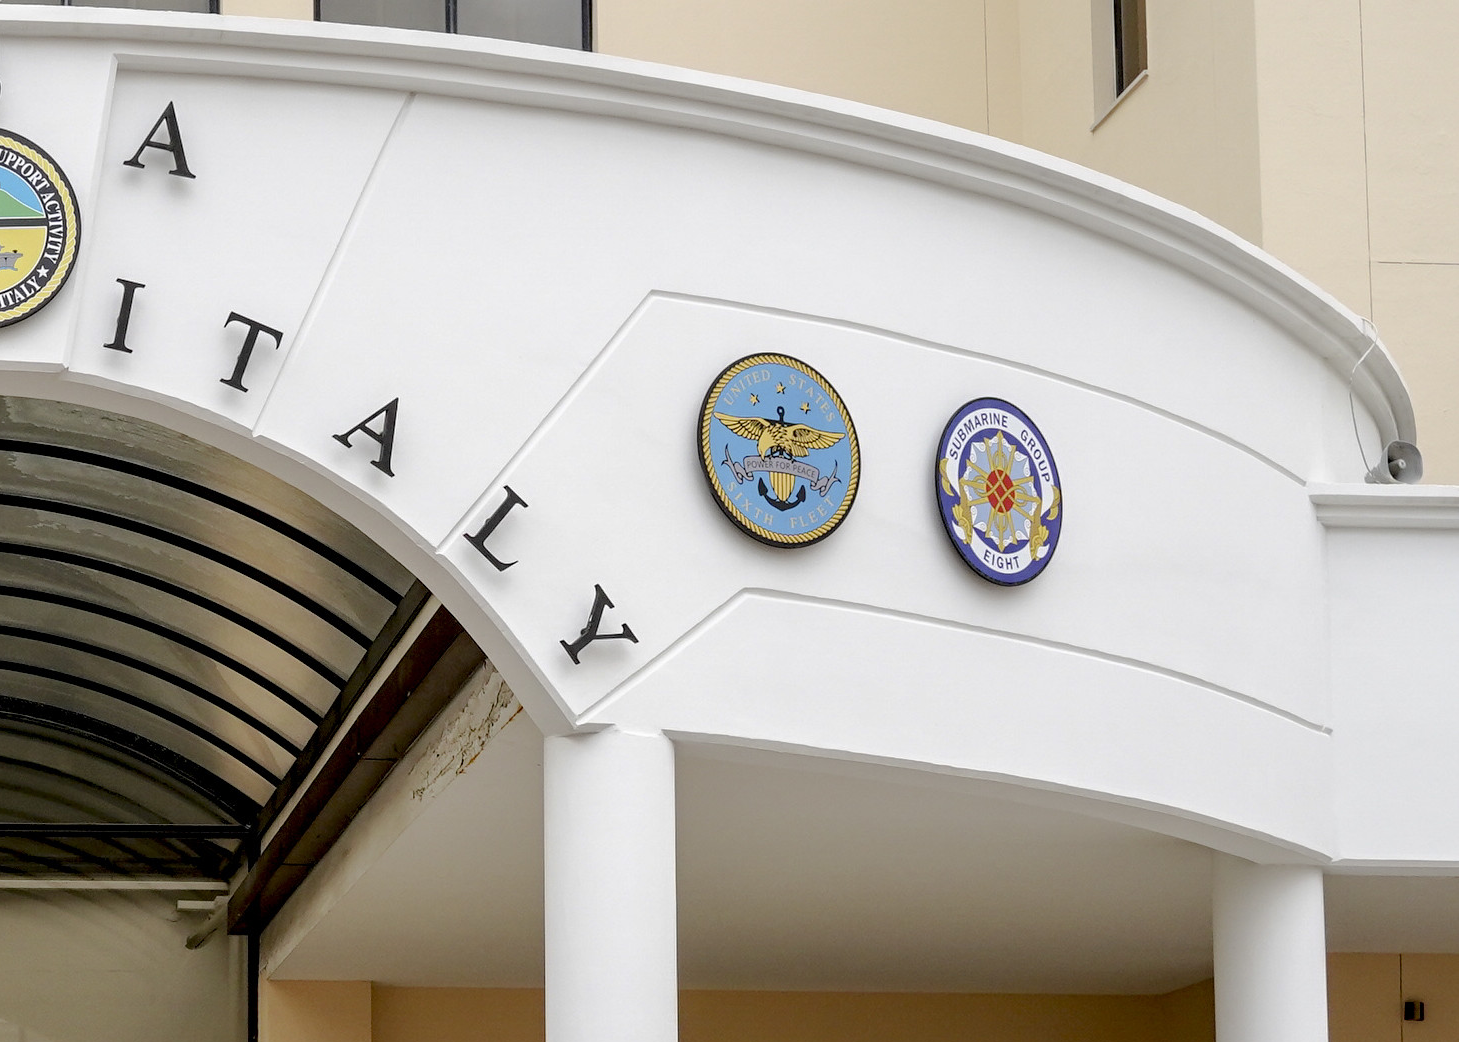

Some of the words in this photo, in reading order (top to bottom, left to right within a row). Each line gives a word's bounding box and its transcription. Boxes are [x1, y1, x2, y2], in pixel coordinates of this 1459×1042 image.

[40, 191, 64, 265] ACTIVITY
[722, 369, 771, 406] UNITED
[788, 374, 835, 423] STATES
[103, 278, 639, 665] ITALY
[746, 460, 774, 469] POWER
[775, 462, 791, 471] FOR
[792, 464, 816, 478] PEACE
[949, 412, 1009, 461] SUBMARINE
[1020, 429, 1051, 483] GROUP
[727, 481, 774, 526] SIXTH
[790, 496, 835, 530] FLEET
[983, 549, 1020, 570] EIGHT
